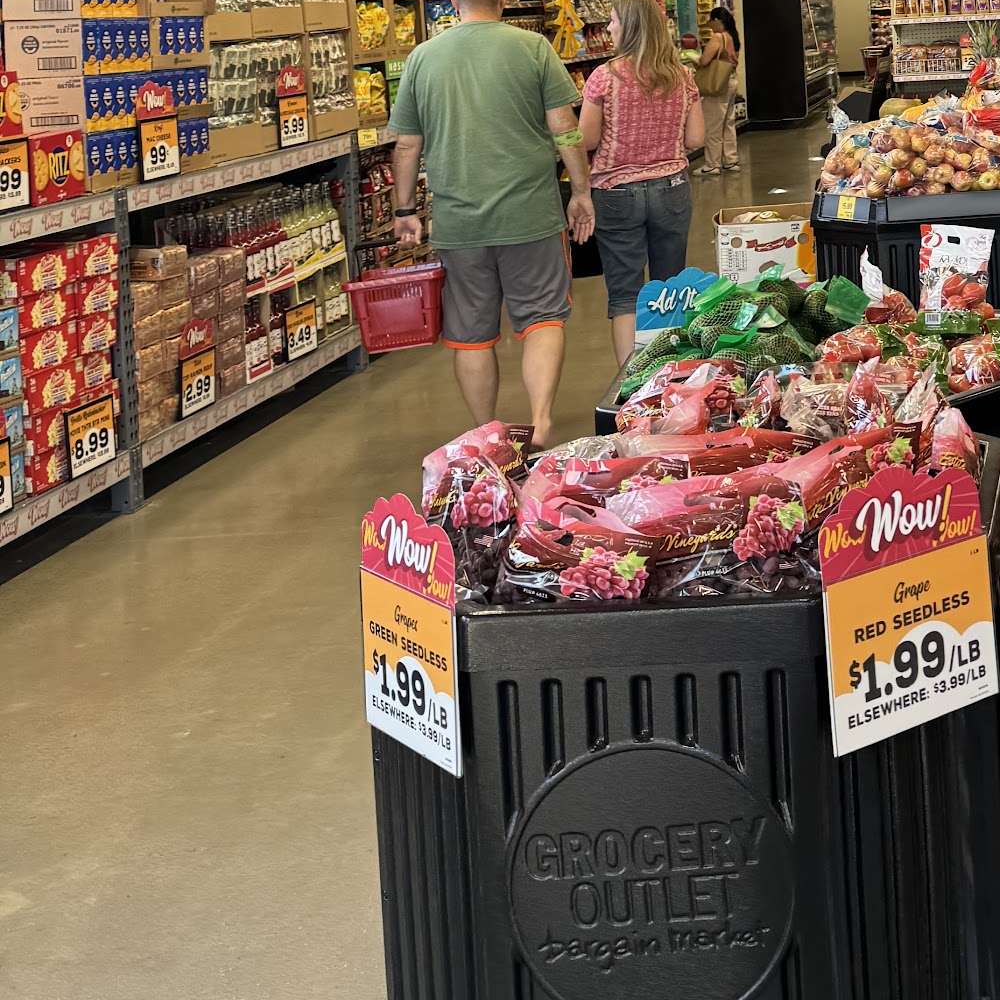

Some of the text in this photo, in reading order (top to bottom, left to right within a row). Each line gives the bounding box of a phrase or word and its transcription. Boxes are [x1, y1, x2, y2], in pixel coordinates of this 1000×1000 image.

[143, 89, 167, 112] Wow!
[48, 150, 70, 181] RITZ
[647, 285, 698, 314] Ad It
[71, 427, 109, 460] $8.99
[855, 483, 953, 553] Wow!
[381, 514, 438, 584] Wow!
[854, 590, 970, 644] RED SEEDLESS
[893, 581, 931, 604] Grape
[369, 621, 448, 672] GREEN SEEDLESS
[849, 630, 981, 703] $1.99/LB
[372, 649, 448, 731] $1.99/LB
[847, 664, 987, 730] ELSEWHERE: $3.99/LB
[372, 694, 452, 751] ELSEWHERE: $3.99/LB
[525, 816, 768, 882] GROCERY
[570, 871, 740, 930] OUTLET
[537, 927, 659, 976] bargain
